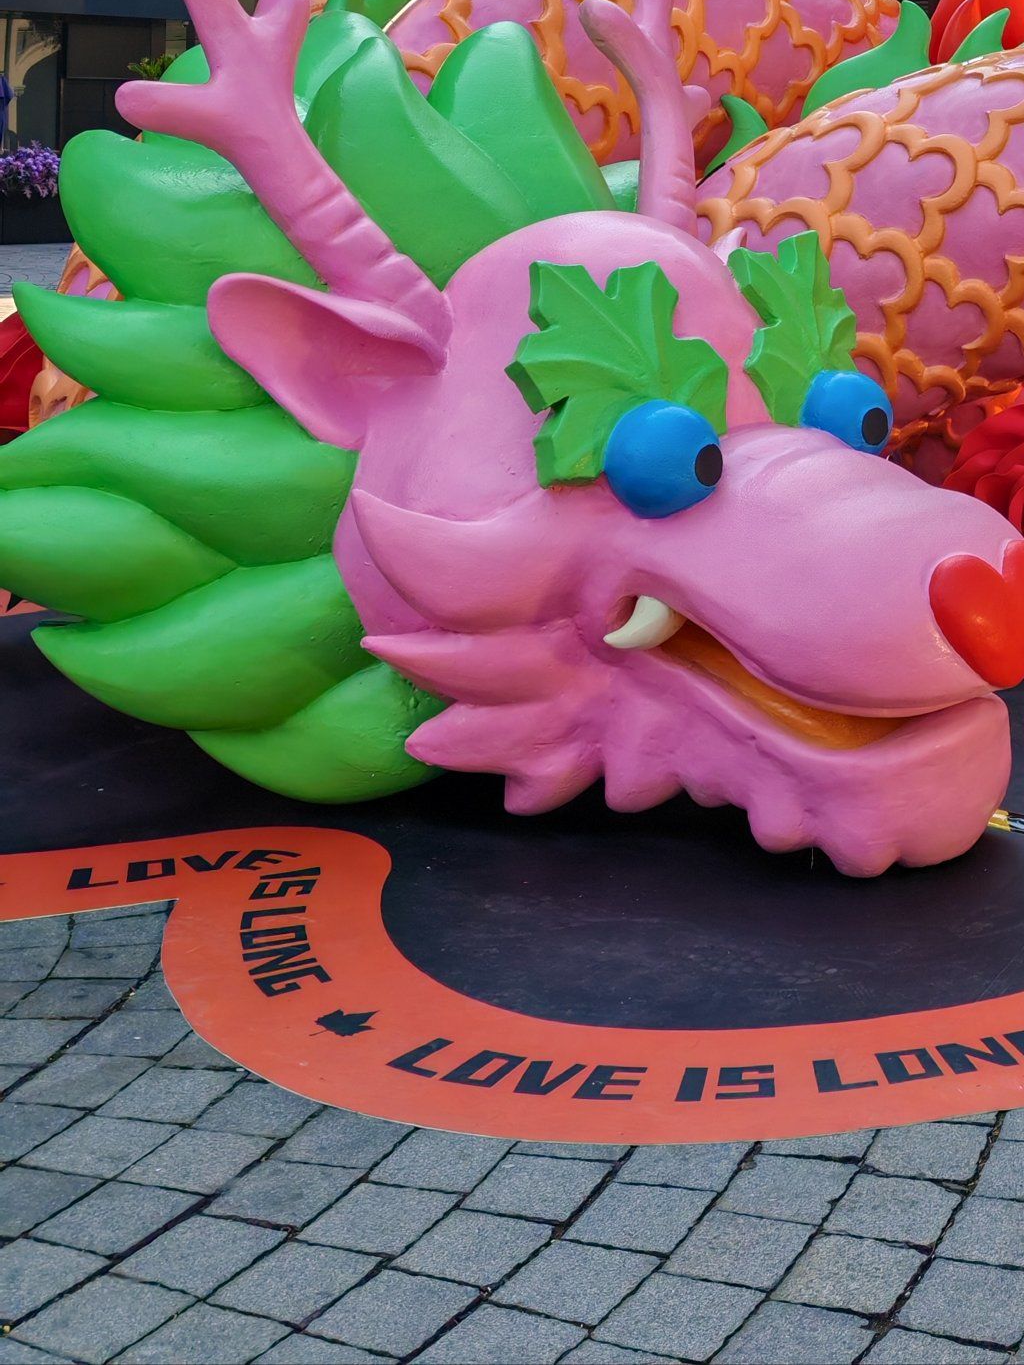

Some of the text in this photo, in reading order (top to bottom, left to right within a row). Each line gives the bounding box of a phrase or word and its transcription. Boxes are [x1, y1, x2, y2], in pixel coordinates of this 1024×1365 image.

[66, 849, 333, 998] LOVE IS LONG
[386, 1037, 648, 1101] LOVE
[675, 1064, 776, 1102] IS
